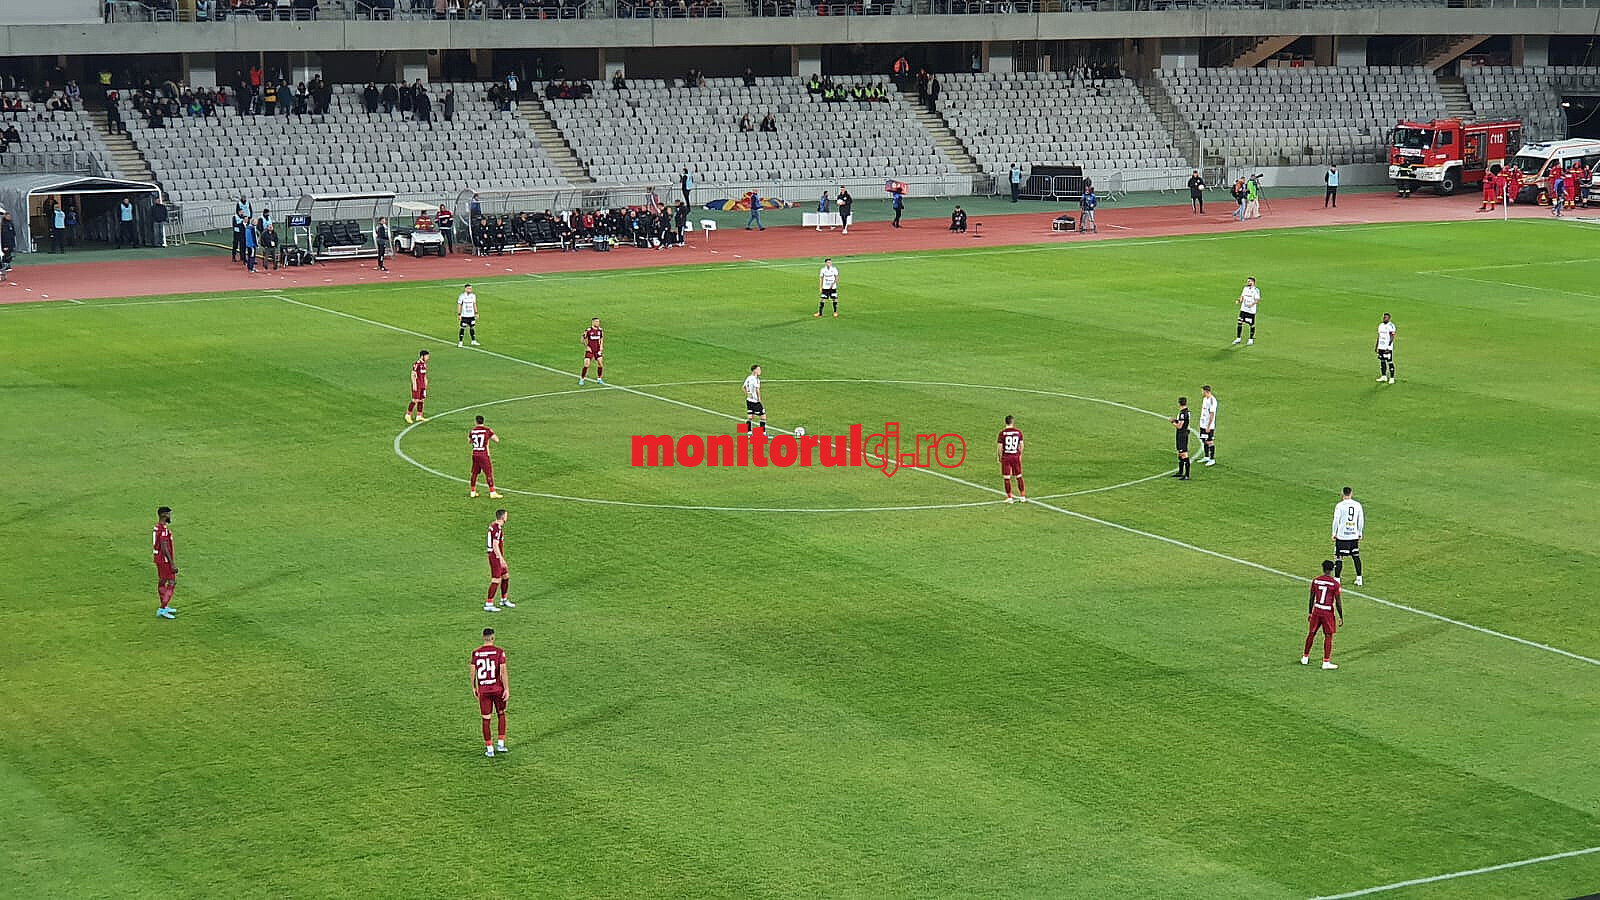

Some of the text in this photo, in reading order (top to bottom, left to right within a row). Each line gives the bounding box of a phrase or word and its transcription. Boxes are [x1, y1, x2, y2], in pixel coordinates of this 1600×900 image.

[471, 433, 485, 448] 37
[1005, 435, 1019, 450] 99
[1347, 506, 1355, 521] 9
[1318, 585, 1328, 604] 7
[476, 658, 496, 680] 24
